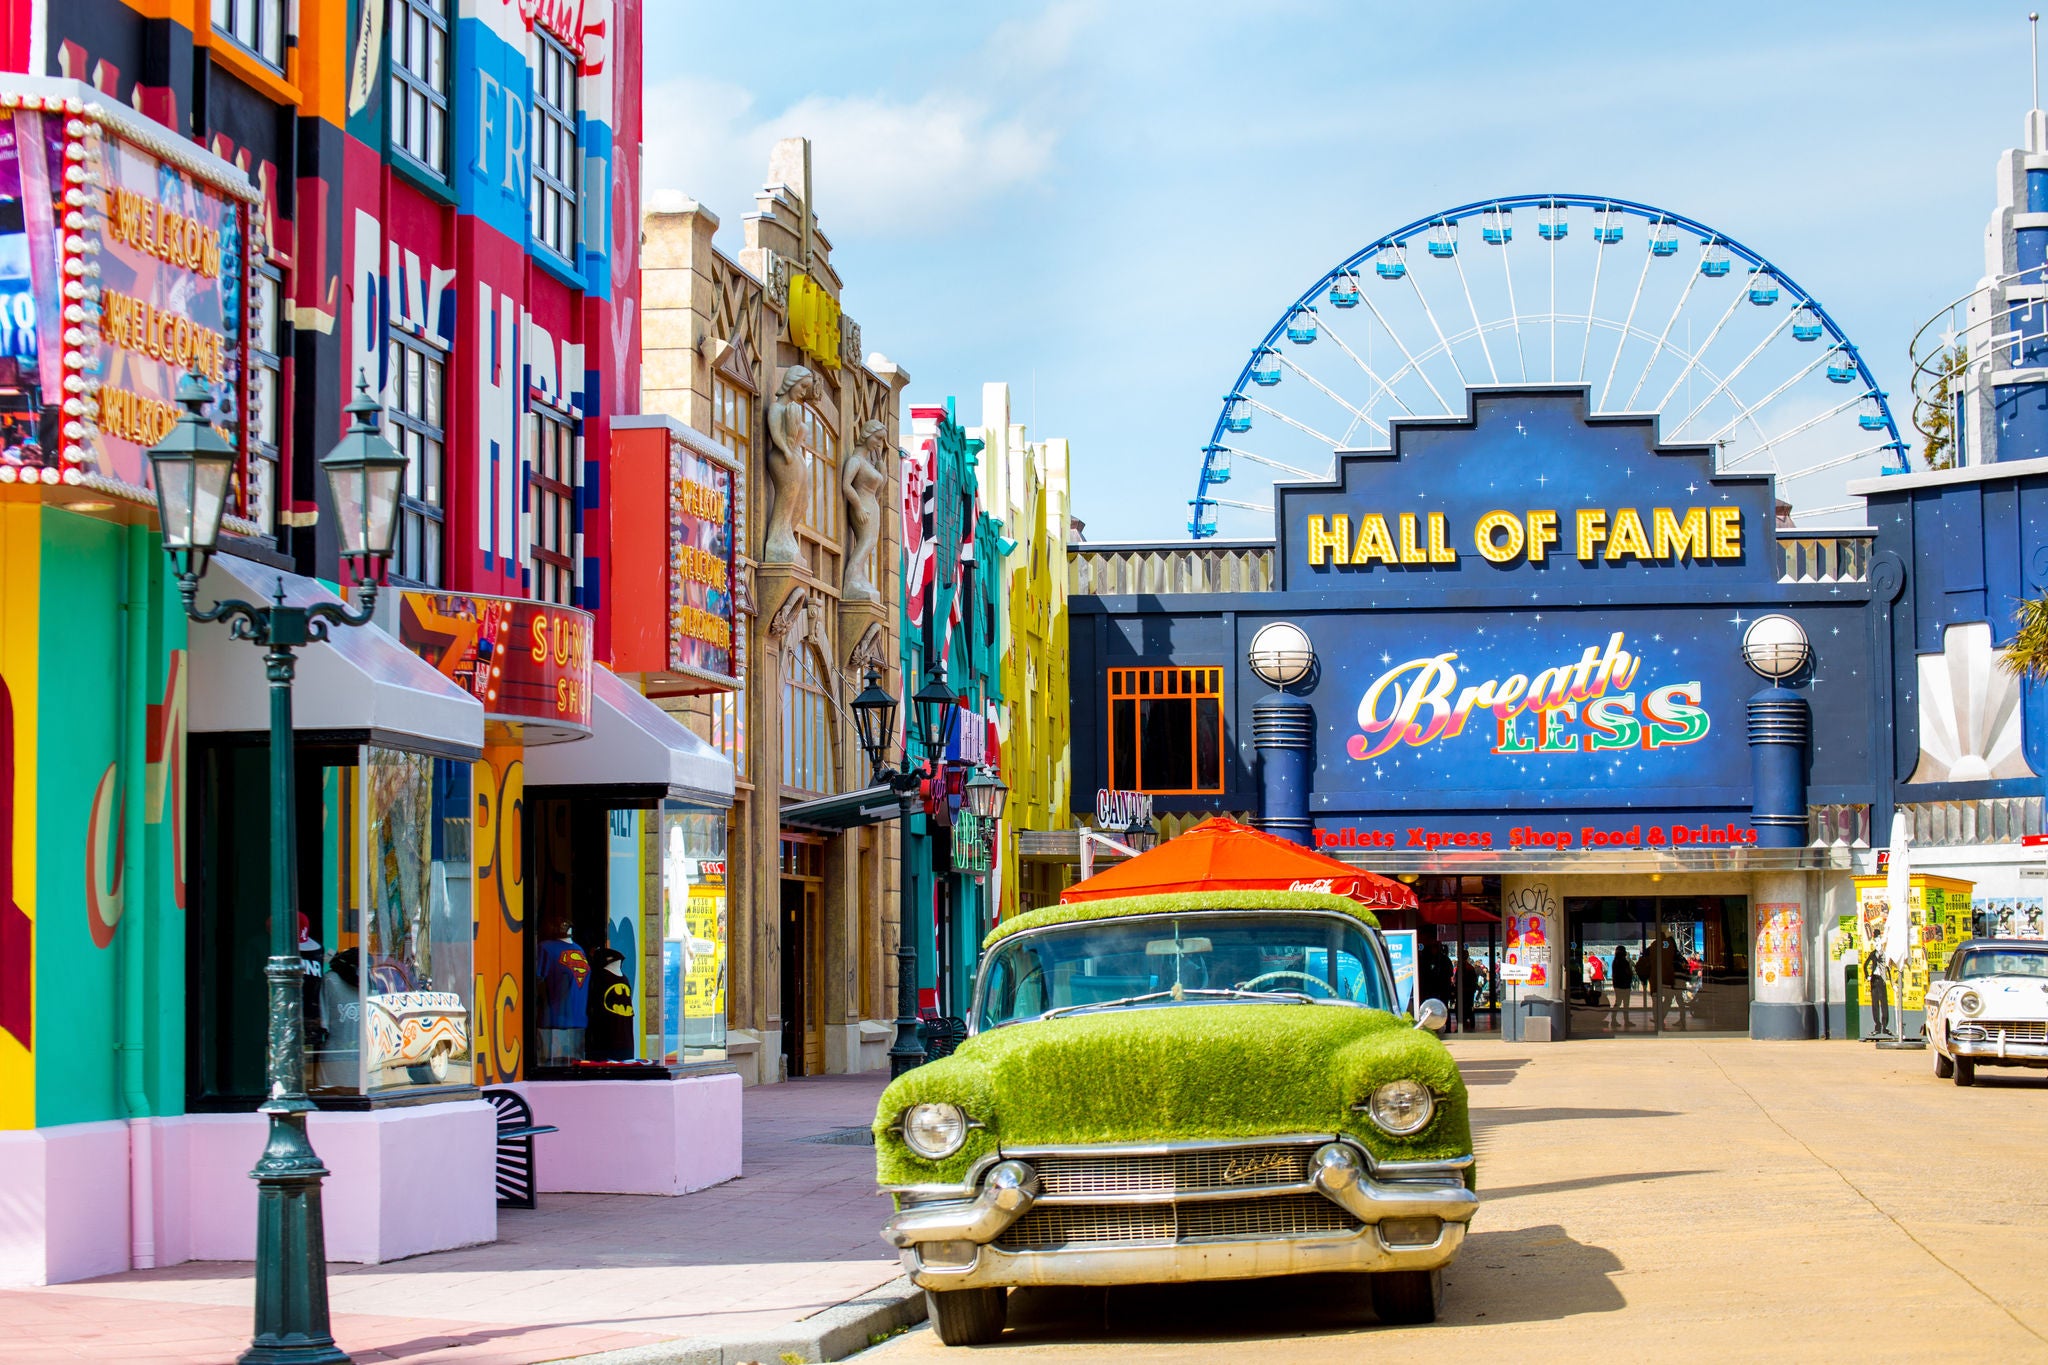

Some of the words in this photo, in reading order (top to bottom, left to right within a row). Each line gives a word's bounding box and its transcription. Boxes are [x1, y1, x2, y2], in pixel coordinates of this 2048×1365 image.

[109, 184, 221, 280] WELKOM
[102, 288, 226, 384] WELCOME
[680, 476, 726, 525] WELKOM
[1308, 512, 1456, 566] HALL
[1474, 509, 1557, 562] OF
[1576, 506, 1742, 561] FAME
[679, 543, 728, 594] WELCOME
[1346, 632, 1642, 760] Breath
[1490, 681, 1710, 755] LESS
[1097, 788, 1143, 829] CANDY
[1312, 827, 1395, 848] Toilets
[1406, 826, 1492, 851] Xpress
[1509, 825, 1572, 850] Shop
[1582, 825, 1641, 847] Food
[1647, 825, 1665, 846] &
[1673, 823, 1758, 846] Drinks
[1945, 902, 1972, 911] OSBOURNE
[1951, 894, 1965, 903] OZZY
[1223, 1152, 1295, 1183] Cadillac
